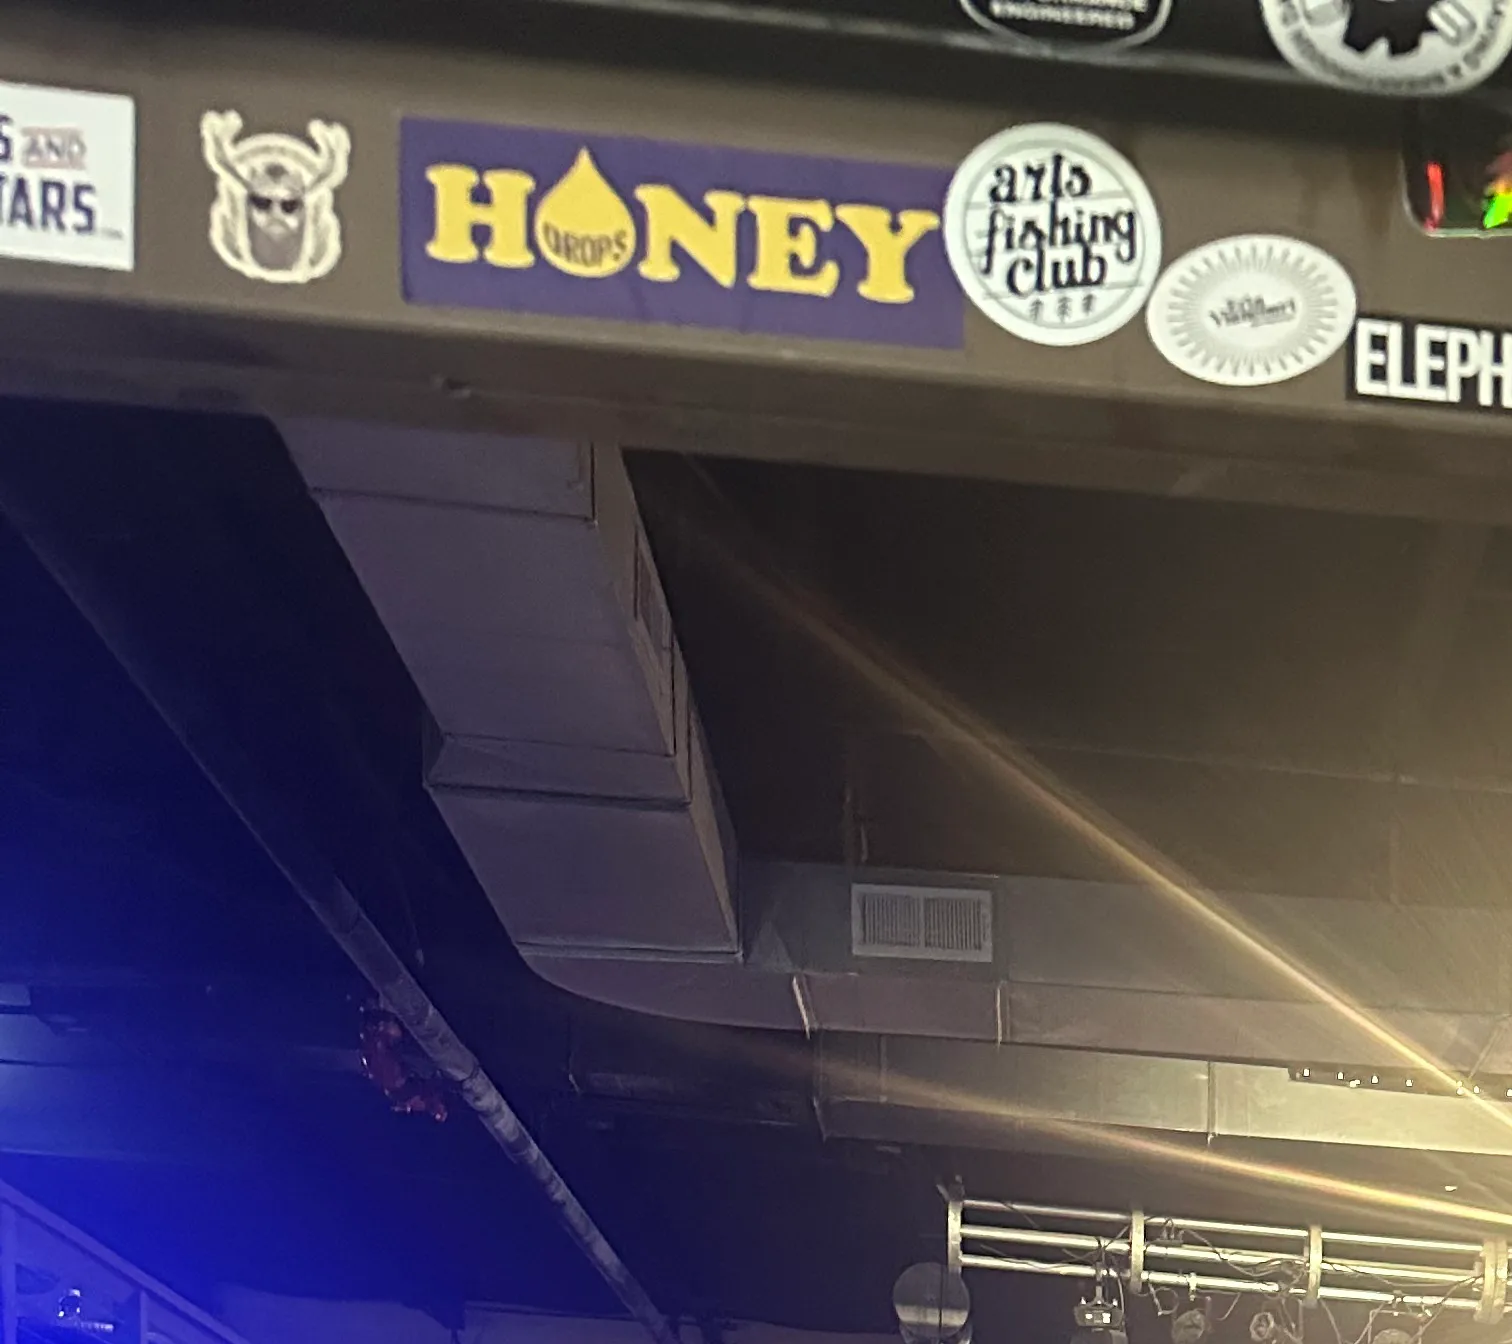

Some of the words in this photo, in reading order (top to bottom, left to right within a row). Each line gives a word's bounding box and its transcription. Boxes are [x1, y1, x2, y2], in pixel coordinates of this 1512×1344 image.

[987, 152, 1093, 206] arts
[425, 148, 940, 304] HONEY
[542, 221, 630, 269] DROPS
[979, 200, 1137, 276] fishing
[1006, 240, 1108, 297] club
